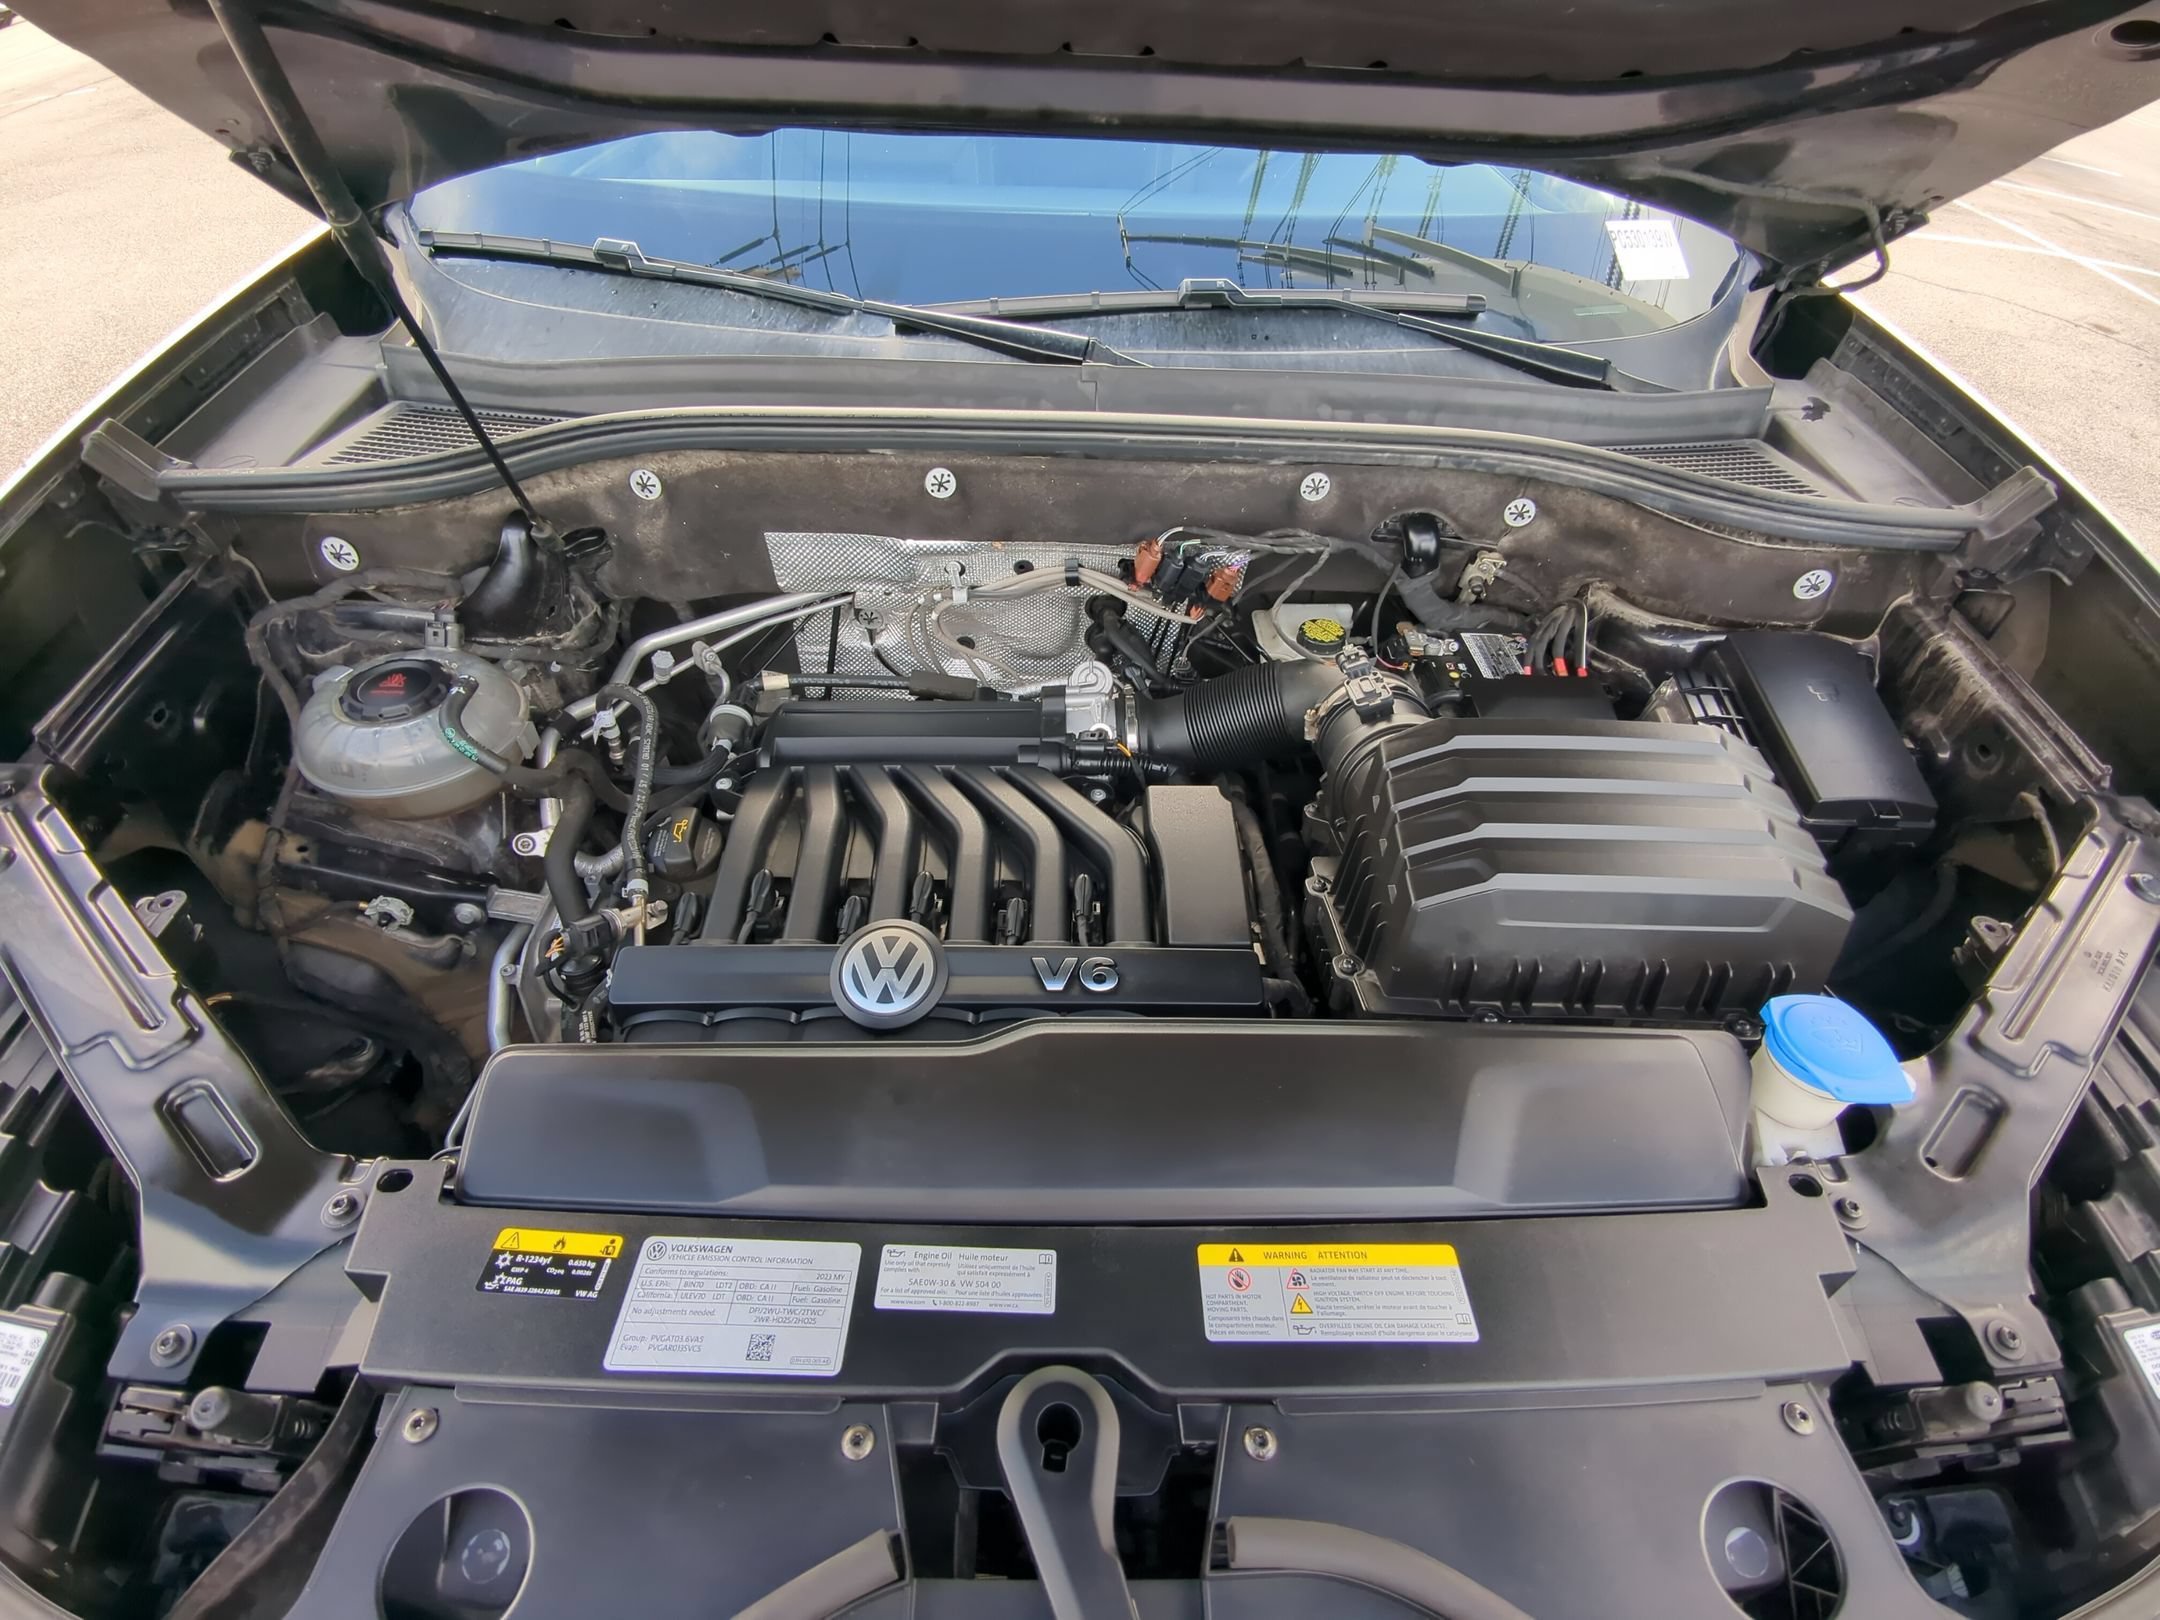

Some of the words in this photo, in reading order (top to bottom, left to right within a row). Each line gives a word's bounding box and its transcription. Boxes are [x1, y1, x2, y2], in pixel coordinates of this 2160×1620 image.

[1032, 957, 1119, 991] V6
[671, 1244, 733, 1253] VOLKSWAGEN
[914, 1251, 939, 1260] Engine
[941, 1252, 953, 1260] Oil
[958, 1253, 979, 1261] Huile
[980, 1254, 1008, 1262] moteur
[1263, 1251, 1308, 1260] WARNING
[1318, 1251, 1368, 1259] ATTENTION
[516, 1254, 552, 1265] R-1234yf
[587, 1260, 596, 1269] kg
[765, 1257, 813, 1265] INFORMATION
[645, 1267, 678, 1275] Conforms
[688, 1269, 728, 1277] regulations:
[505, 1276, 523, 1285] PAG
[975, 1280, 989, 1288] 504
[794, 1284, 810, 1292] Fuel:
[813, 1285, 843, 1293] Gasoline
[587, 1290, 599, 1298] AG
[811, 1296, 841, 1304] Gasoline
[643, 1307, 687, 1316] adjustments
